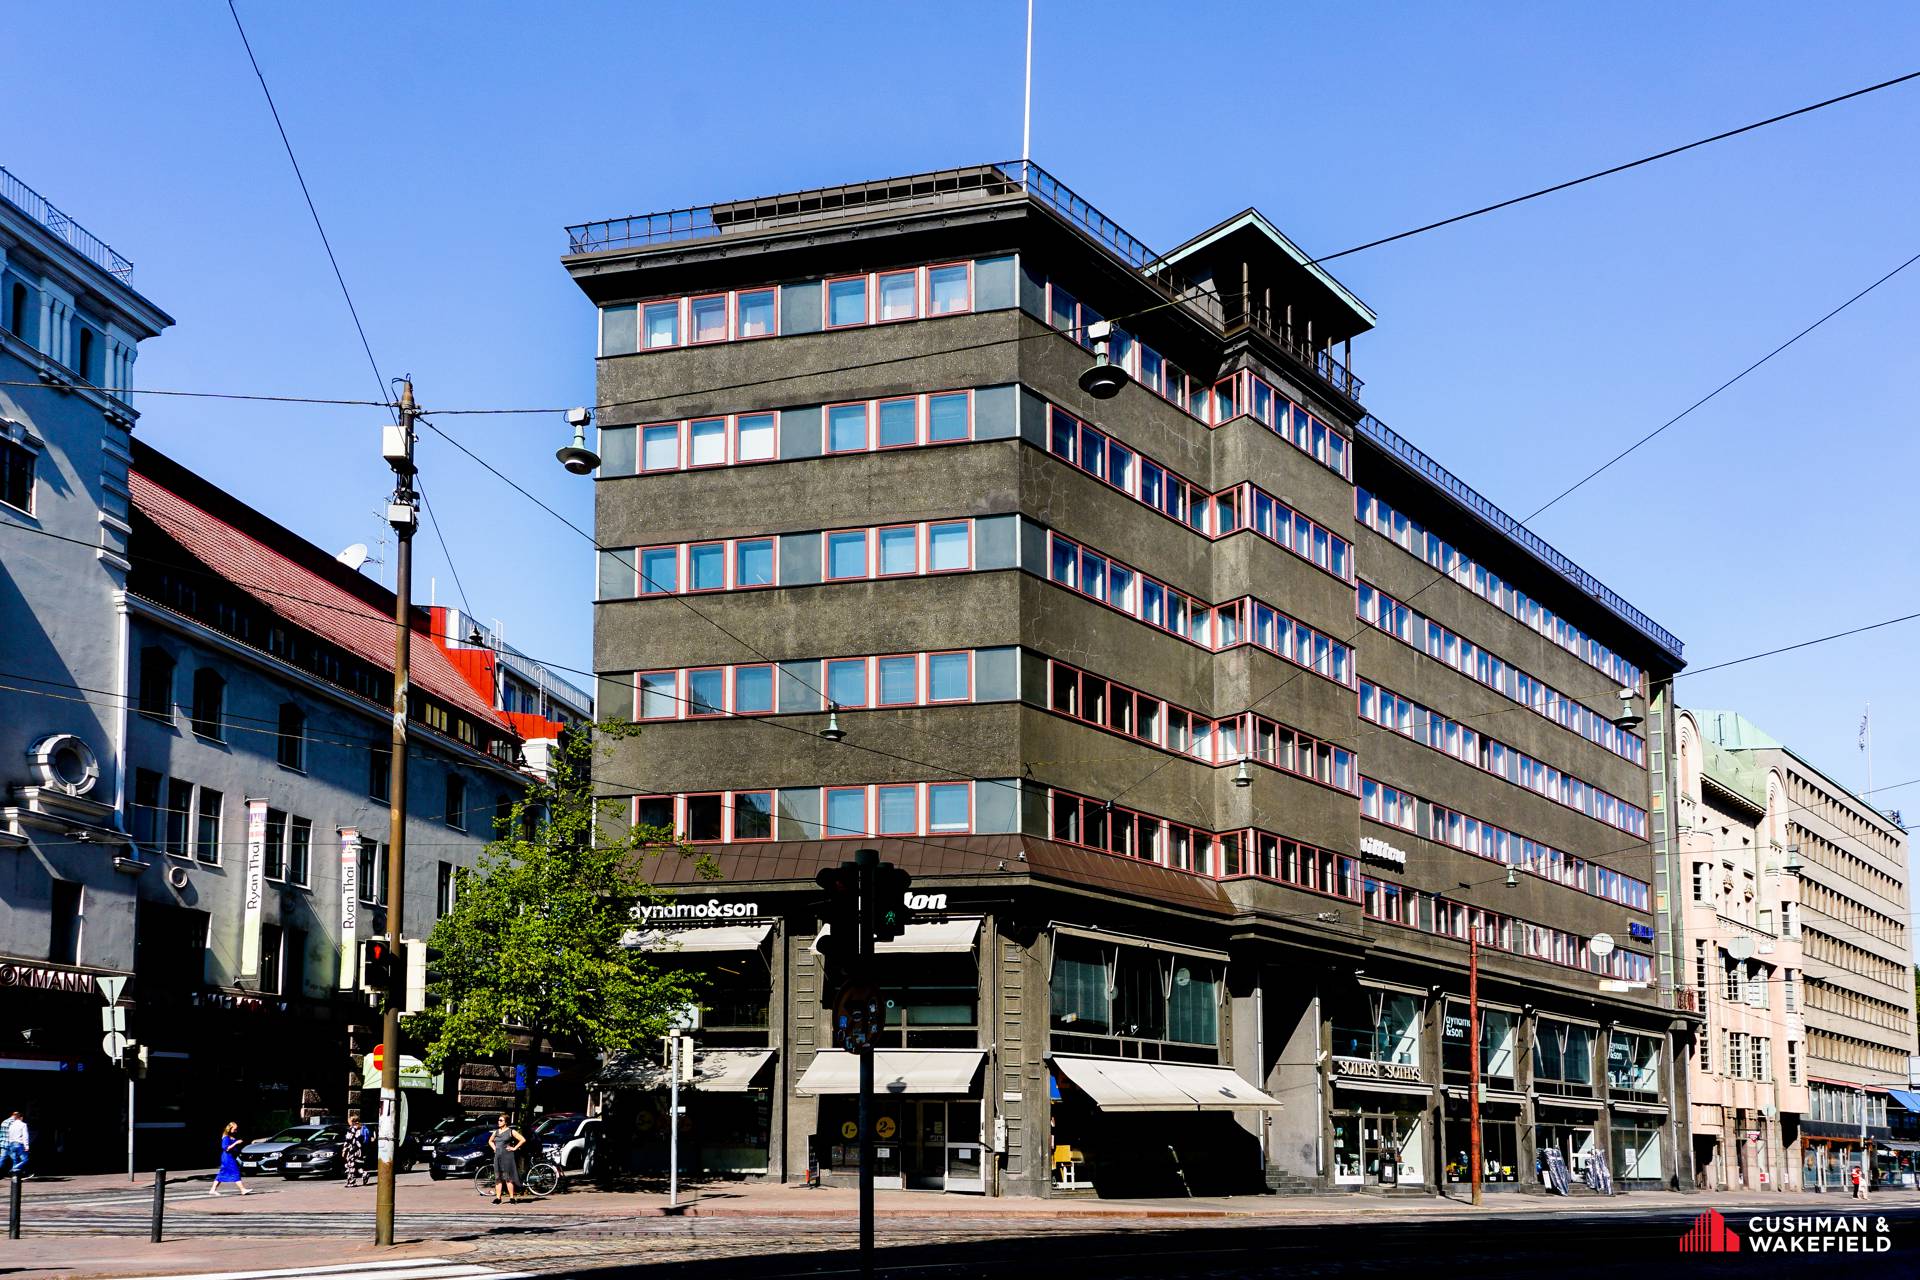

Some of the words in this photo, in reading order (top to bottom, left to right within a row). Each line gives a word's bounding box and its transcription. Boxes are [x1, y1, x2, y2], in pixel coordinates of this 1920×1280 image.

[249, 841, 260, 872] Thai
[247, 875, 260, 910] Ryan
[343, 866, 354, 894] Thai
[343, 897, 355, 929] Ryan
[1338, 1060, 1378, 1078] SOTHYS
[1384, 1064, 1421, 1081] SOTHYS
